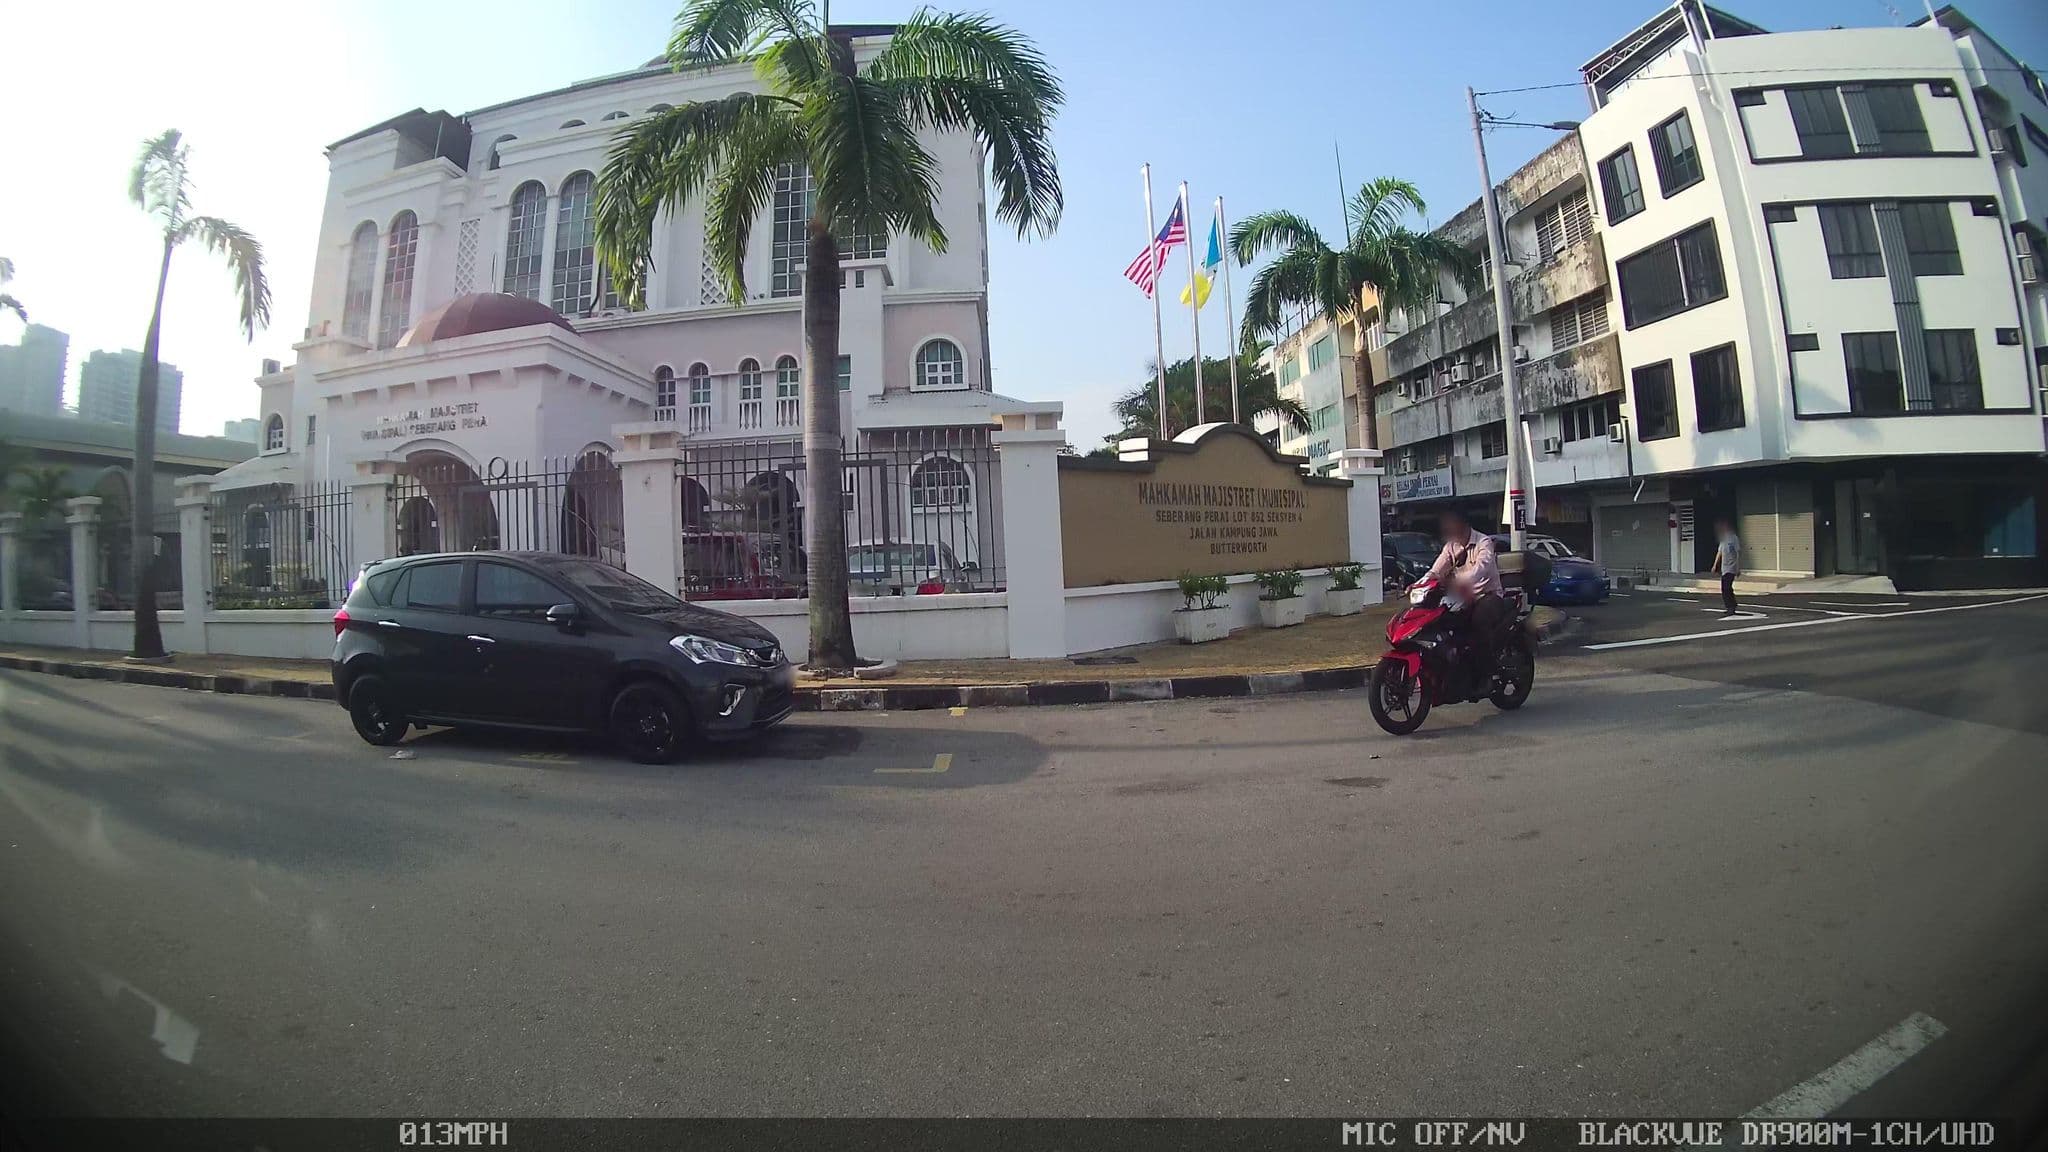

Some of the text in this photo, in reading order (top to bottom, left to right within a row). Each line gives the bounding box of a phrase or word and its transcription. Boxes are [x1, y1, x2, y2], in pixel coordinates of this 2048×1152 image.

[1138, 481, 1201, 506] MAHKAMAH
[1203, 485, 1255, 507] MAJISTRET
[1155, 510, 1201, 523] SEBERANG
[1204, 511, 1229, 523] PERAI
[1233, 511, 1247, 523] LOT
[1267, 511, 1297, 523] SEKSYEN
[1189, 526, 1279, 540] JALAN KAMPUNG JAWA
[1210, 542, 1268, 555] BUTTERWORTH
